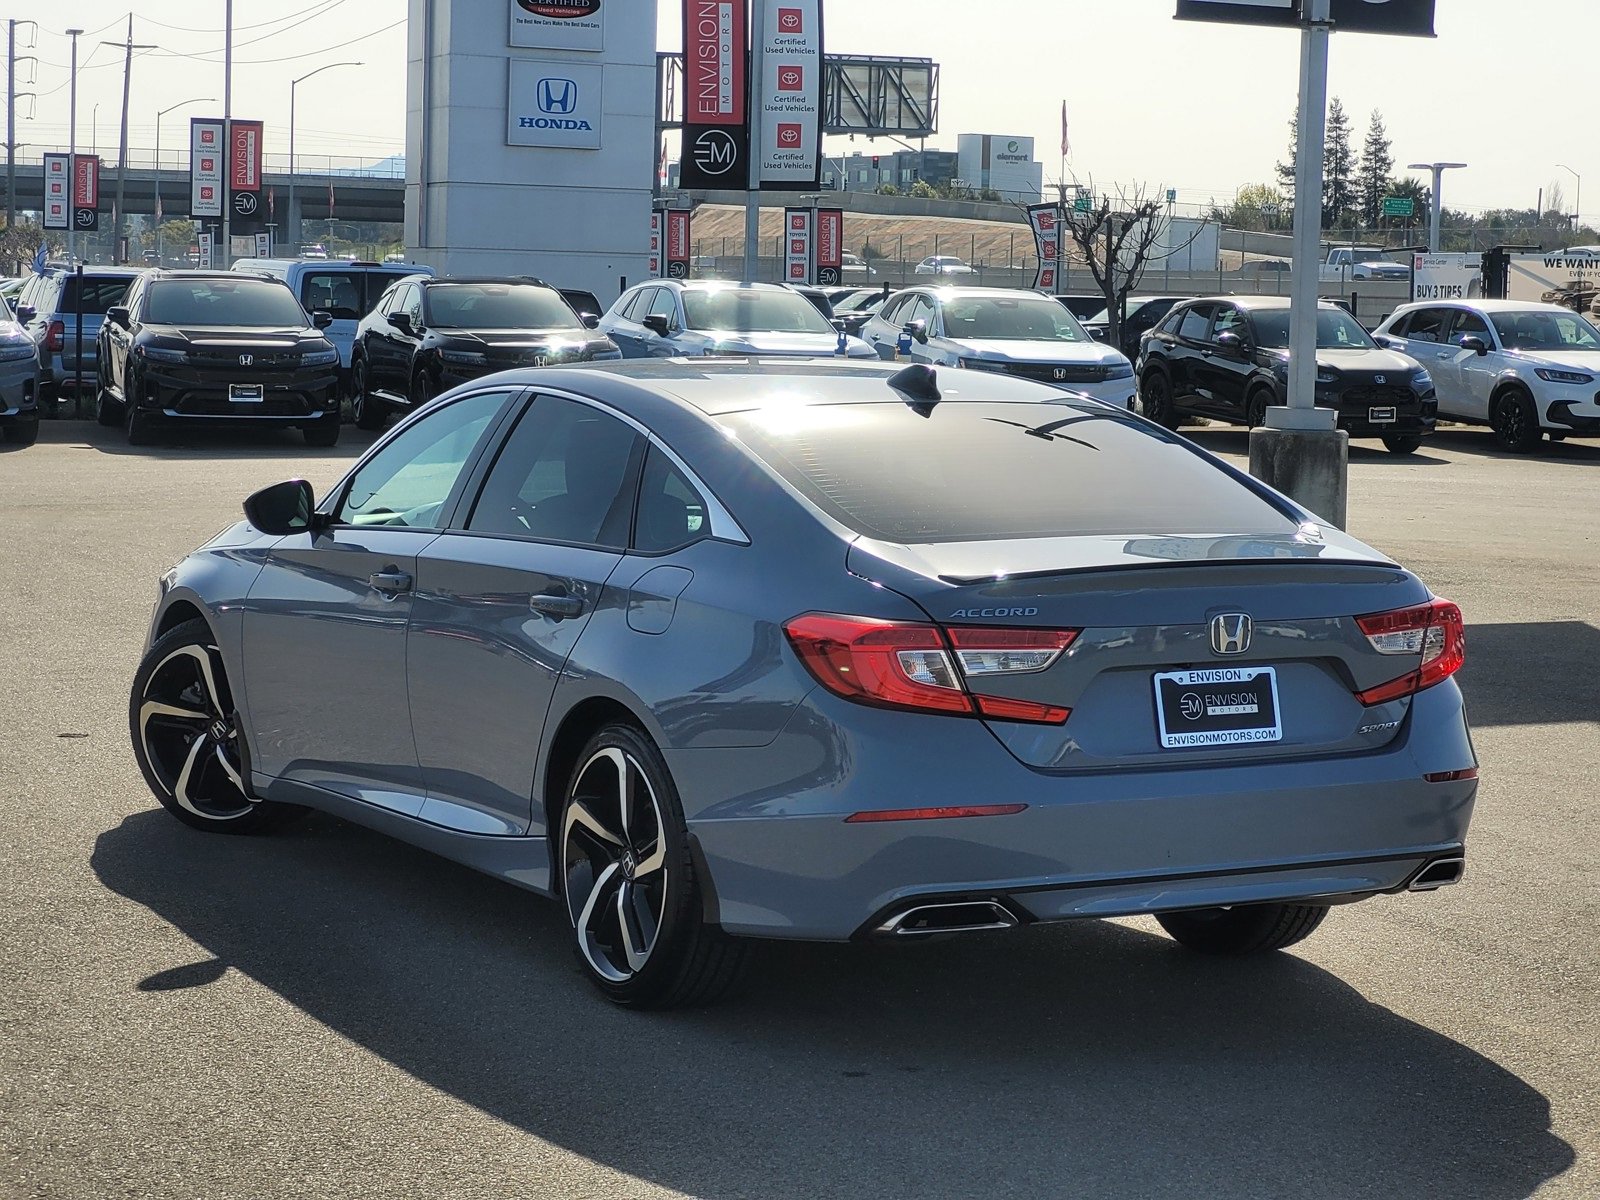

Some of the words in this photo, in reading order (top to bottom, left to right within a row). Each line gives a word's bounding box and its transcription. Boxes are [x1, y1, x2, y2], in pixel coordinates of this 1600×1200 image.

[774, 38, 807, 46] Certified
[698, 1, 717, 113] ENVISION
[785, 47, 815, 55] Vehicles
[722, 12, 730, 104] MOTORS
[774, 95, 806, 103] Certified
[519, 117, 593, 131] HONDA
[236, 130, 247, 185] ENVISION
[773, 153, 804, 161] Certified
[996, 153, 1028, 161] element
[78, 161, 87, 204] ENVISION
[821, 216, 830, 262] ENVISION
[1544, 258, 1563, 268] WE
[1565, 259, 1600, 269] WANT
[1417, 285, 1432, 298] BUY
[1433, 285, 1438, 298] 3
[1440, 285, 1462, 298] TIRES
[949, 607, 1038, 618] ACCORD
[1189, 670, 1241, 683] ENVISION
[1205, 692, 1258, 706] ENVISION
[1358, 720, 1400, 734] SPORT
[1167, 730, 1277, 746] ENVISIONMOTORS.COM
